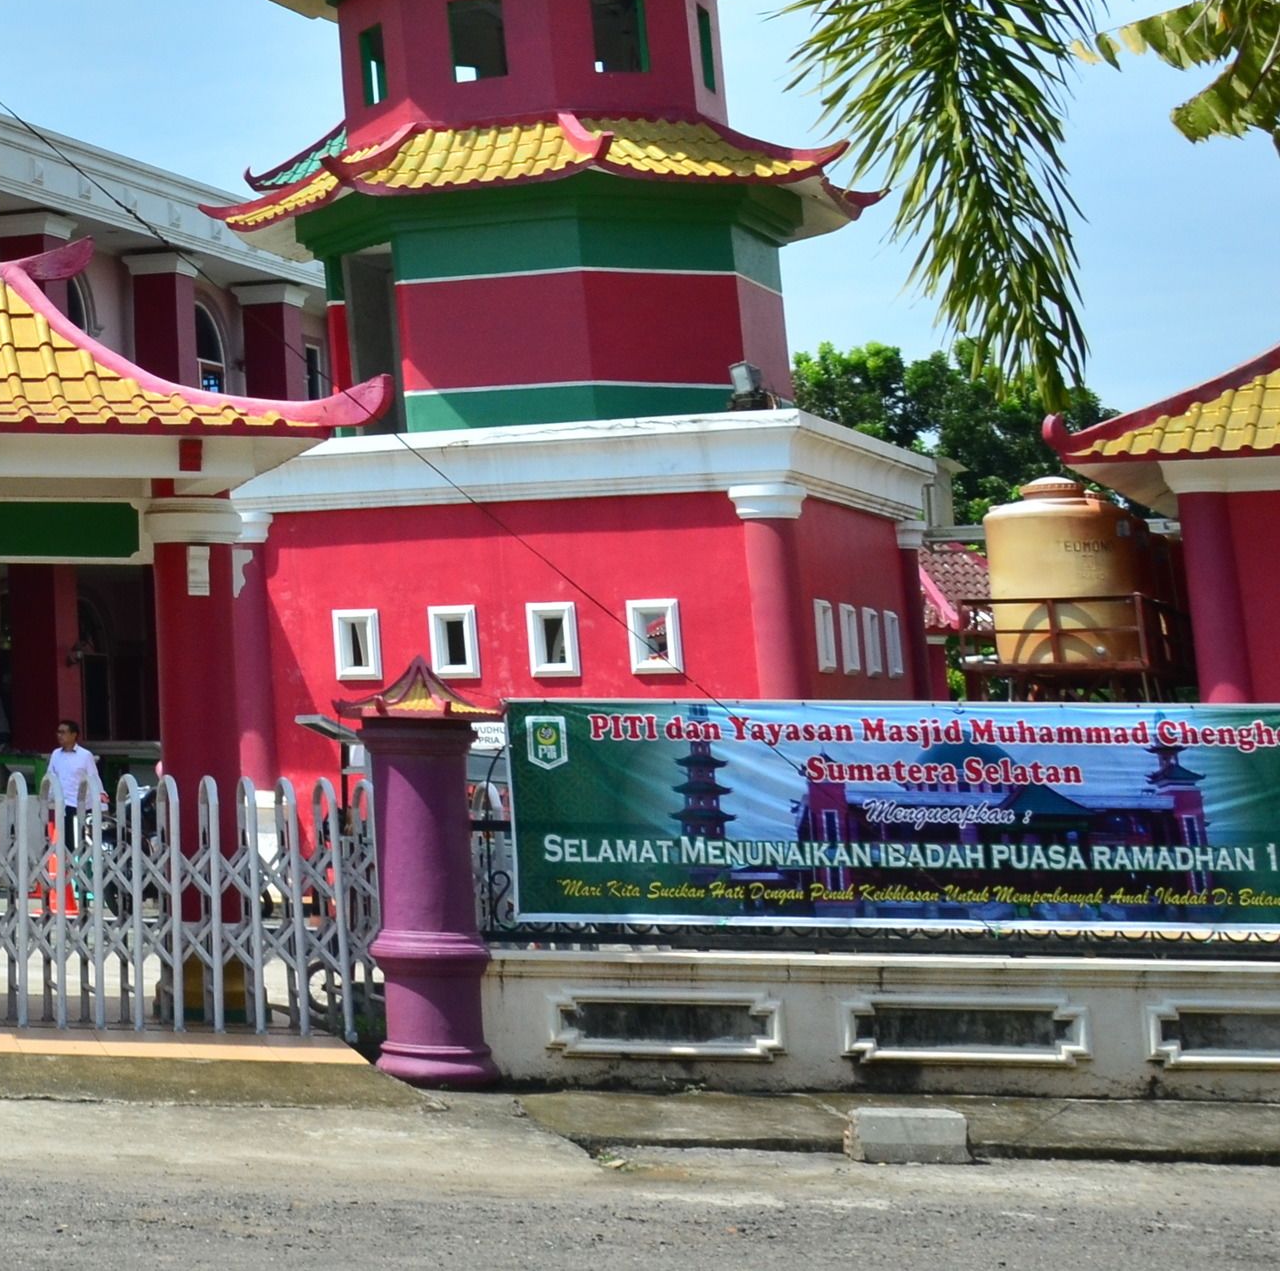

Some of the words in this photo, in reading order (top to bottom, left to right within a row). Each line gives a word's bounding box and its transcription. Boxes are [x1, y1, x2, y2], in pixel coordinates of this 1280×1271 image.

[589, 713, 658, 741] PITI
[665, 716, 722, 742] dan
[728, 716, 854, 746] Yayasan
[860, 718, 965, 749] Masjid
[968, 718, 1150, 746] Muhammad
[806, 756, 958, 784] Sumatera
[963, 756, 1083, 785] Selatan
[862, 798, 1016, 831] Mengucapkan
[543, 833, 674, 864] SELAMAT
[679, 835, 872, 868] MENUNAIKAN
[879, 842, 985, 869] IBADAH
[991, 843, 1088, 871] PUASA
[1092, 844, 1256, 872] RAMADHAN
[607, 879, 641, 898] Kita
[646, 881, 706, 900] Sucikan
[709, 881, 746, 900] Hati
[749, 881, 805, 904] Dengan
[809, 882, 855, 902] Penuh
[858, 883, 939, 903] Keikhlasan
[943, 884, 990, 903] Untuk
[992, 884, 1104, 908] Memperbanyak
[1107, 886, 1150, 906] Amal
[1154, 886, 1208, 906] Ibadah
[1211, 888, 1234, 906] Di
[1238, 887, 1280, 907] Bulan
